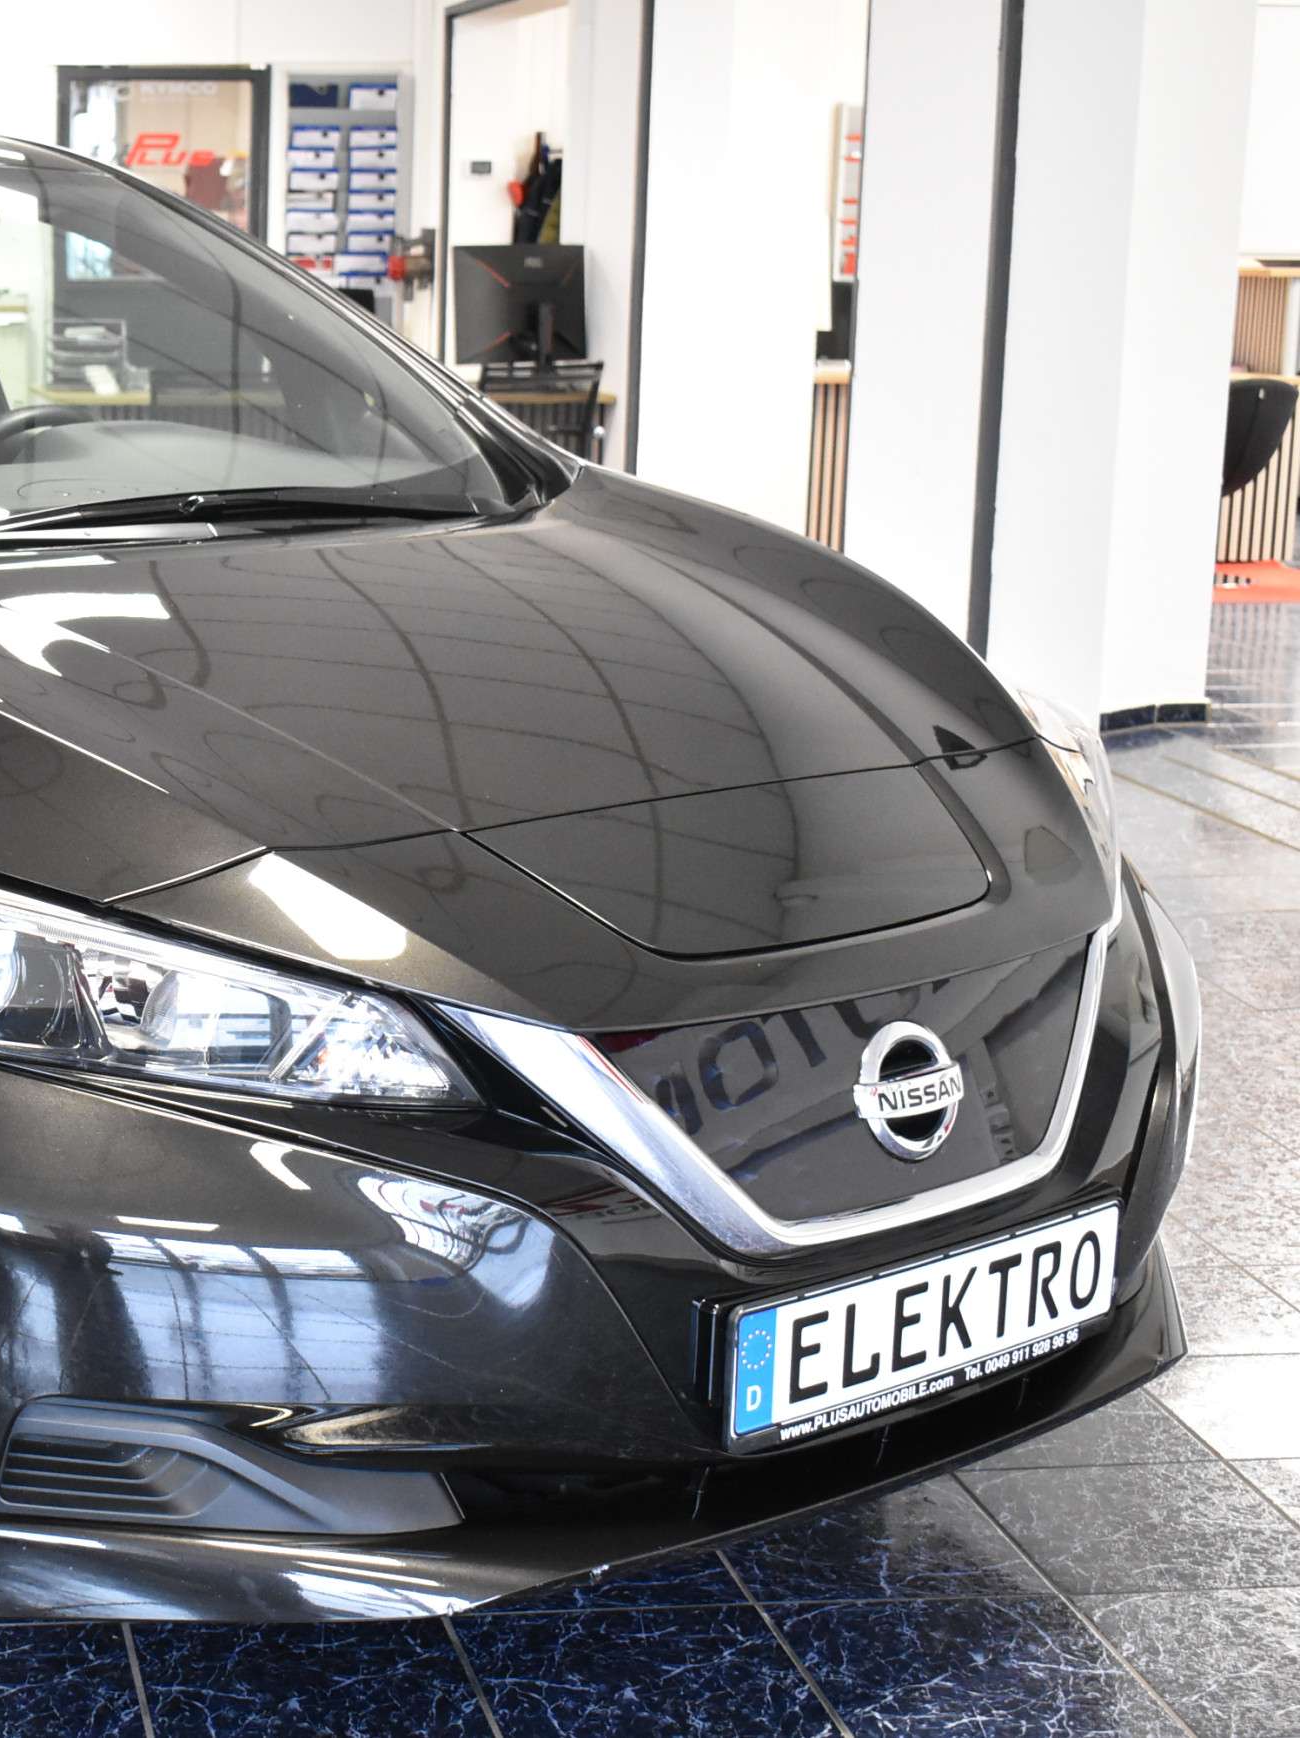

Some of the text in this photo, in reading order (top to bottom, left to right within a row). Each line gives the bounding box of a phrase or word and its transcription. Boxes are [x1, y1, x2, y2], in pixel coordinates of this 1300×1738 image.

[877, 1076, 962, 1112] NISSAN
[788, 1229, 1101, 1405] ELEKTRO
[746, 1385, 762, 1412] D
[780, 1328, 1079, 1442] www.PLUSAUTOMOBILE.com Tel. 0049 911 928 96 96
